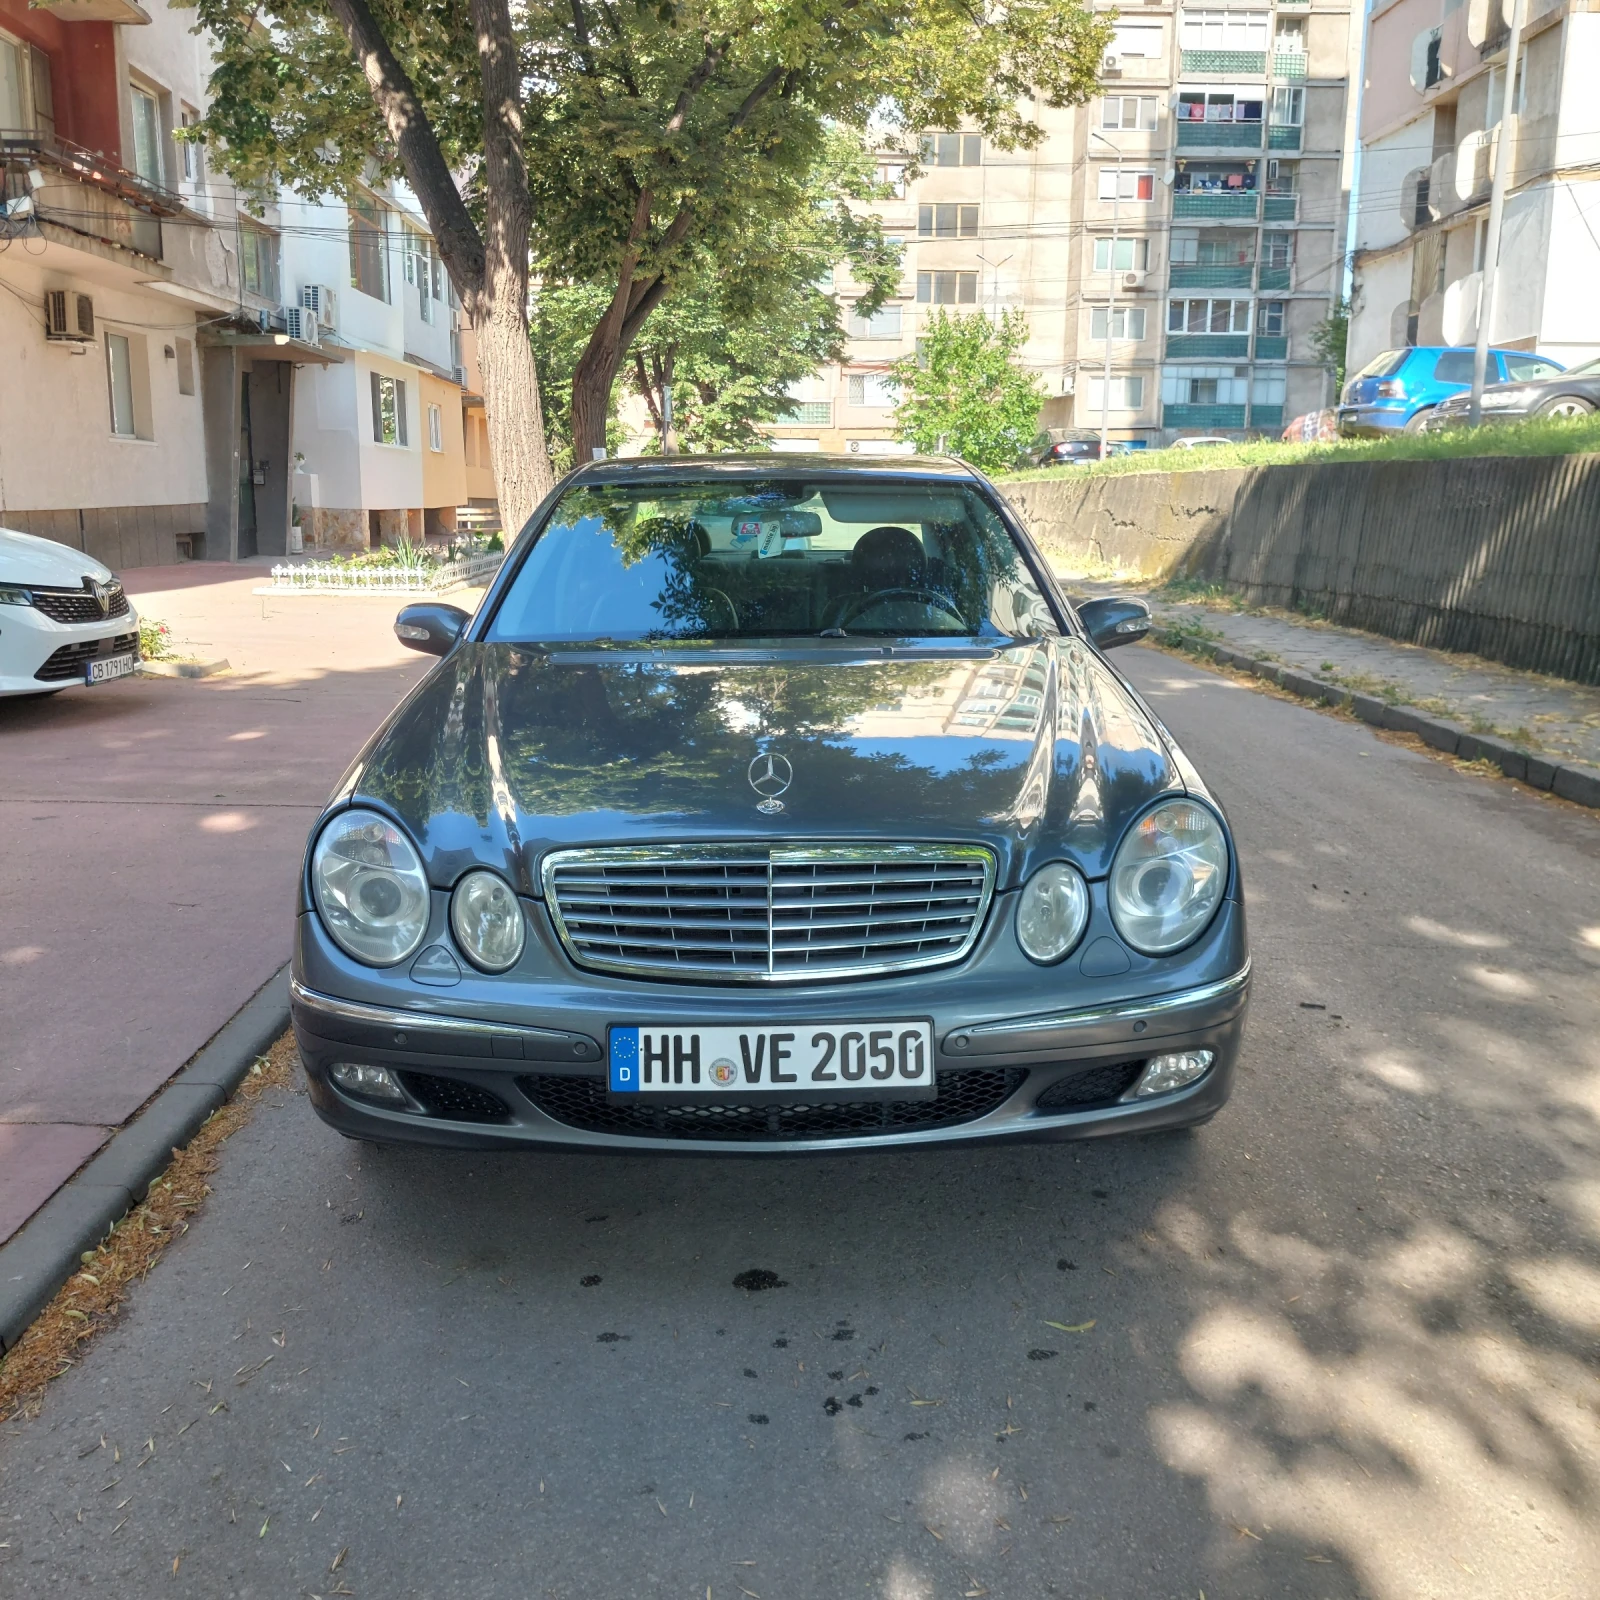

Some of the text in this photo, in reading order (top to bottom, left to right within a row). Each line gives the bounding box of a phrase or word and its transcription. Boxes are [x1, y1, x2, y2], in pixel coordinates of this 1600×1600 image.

[92, 663, 104, 679] CB
[105, 659, 122, 677] 1791
[643, 1034, 701, 1084] HH
[739, 1032, 798, 1084] VE
[811, 1029, 924, 1082] 2050
[619, 1067, 631, 1081] D
